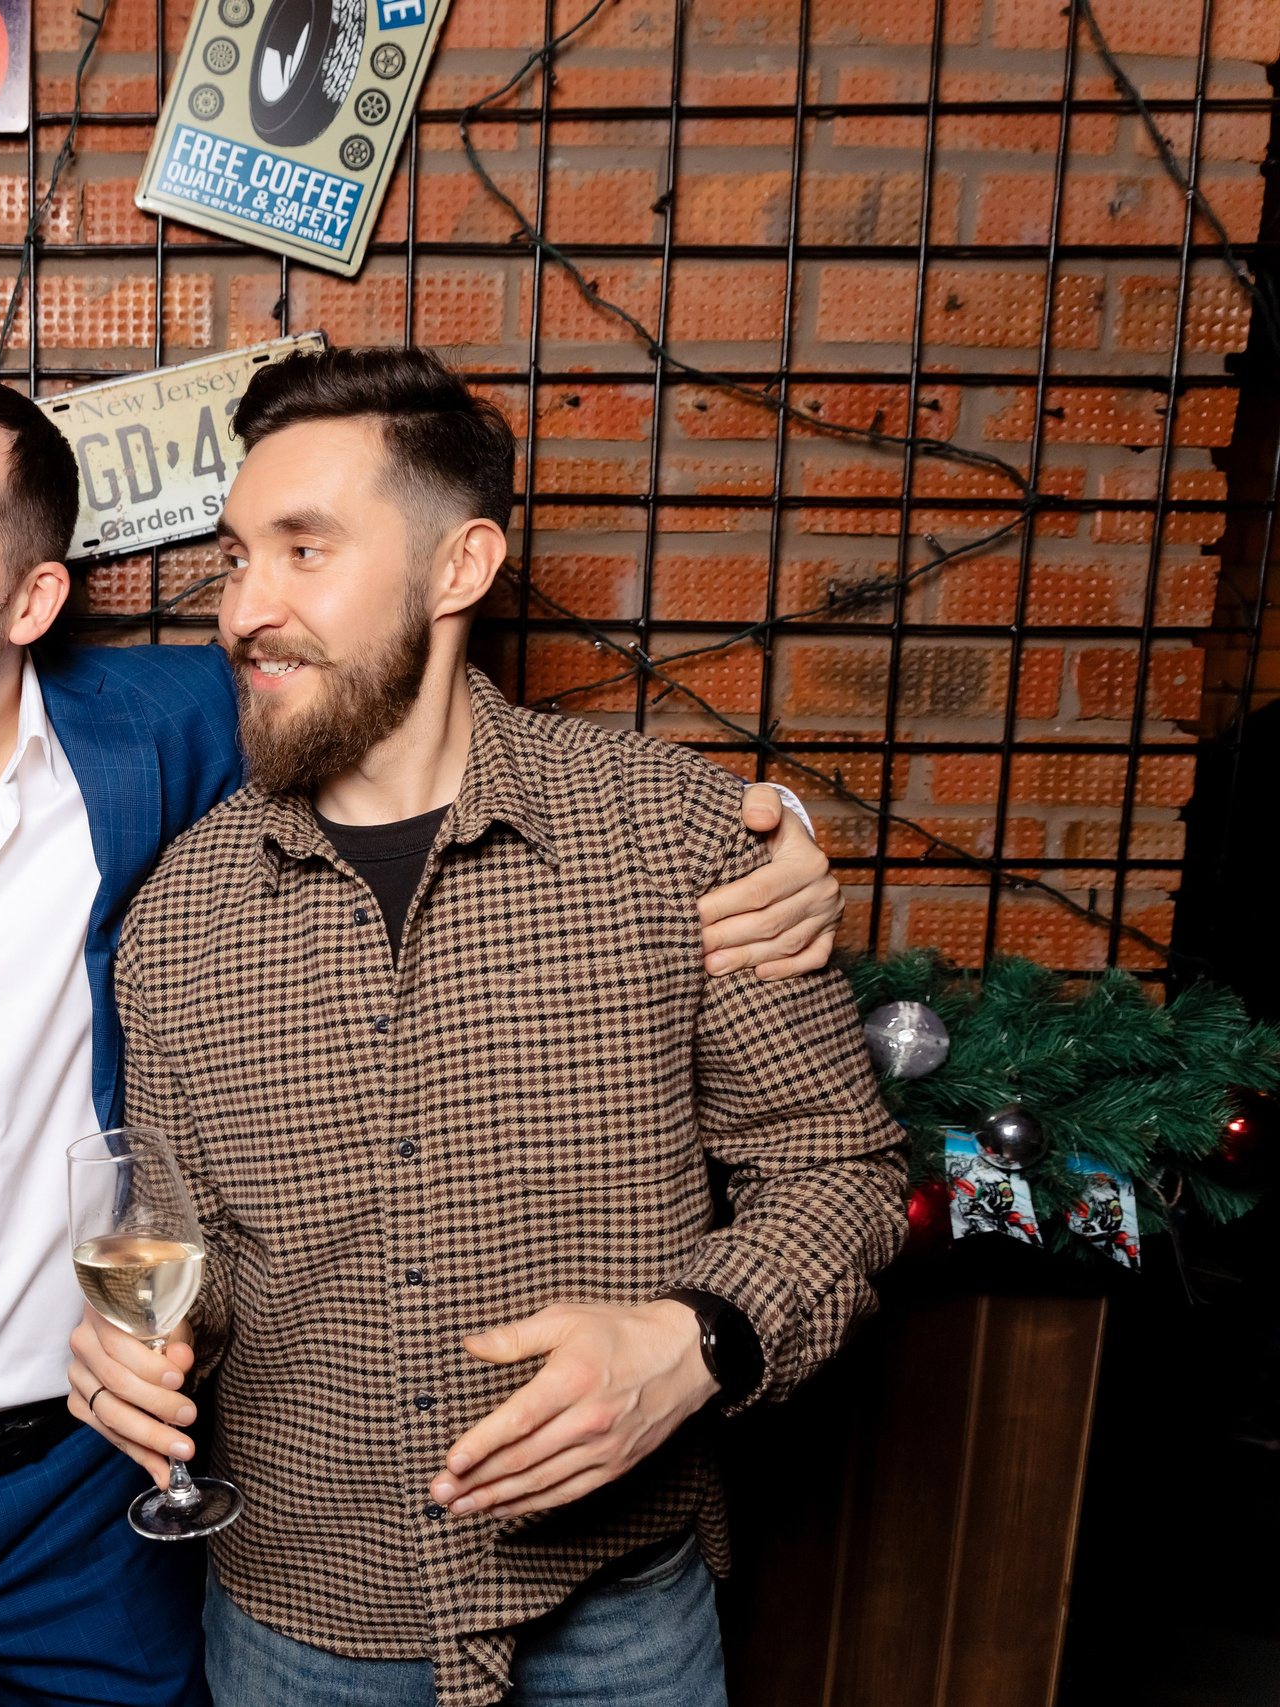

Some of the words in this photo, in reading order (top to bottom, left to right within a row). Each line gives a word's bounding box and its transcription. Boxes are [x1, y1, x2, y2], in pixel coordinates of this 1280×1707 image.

[166, 161, 251, 203] QUALITY
[252, 188, 269, 210] &
[273, 198, 350, 237] SAFETY
[172, 127, 248, 180] FREE
[249, 153, 359, 217] COFFEE
[162, 181, 200, 202] next
[202, 195, 260, 222] service
[261, 210, 297, 233] 500
[297, 222, 342, 248] miles
[77, 392, 145, 425] New
[152, 367, 240, 411] Jersey
[100, 505, 194, 541] Garden
